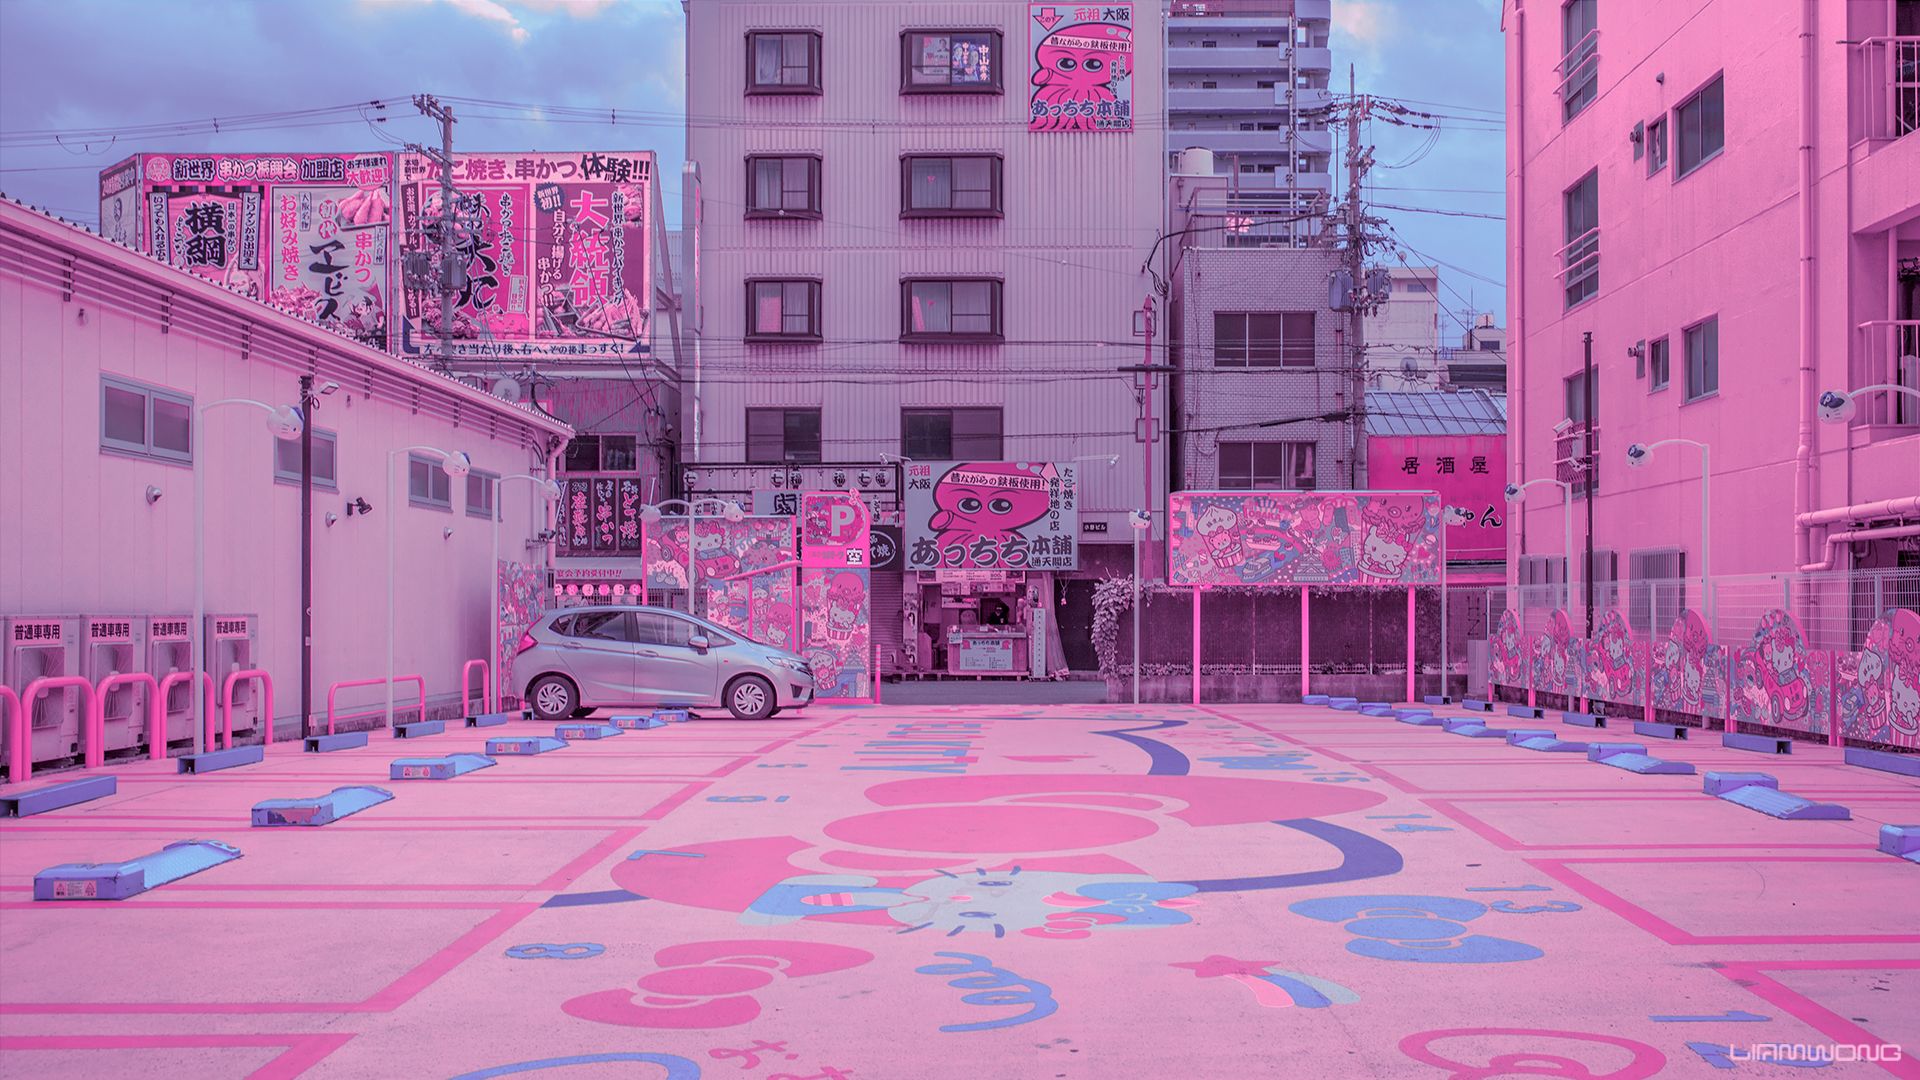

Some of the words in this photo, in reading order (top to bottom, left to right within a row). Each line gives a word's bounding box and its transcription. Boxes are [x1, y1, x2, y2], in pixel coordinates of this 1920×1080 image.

[1074, 8, 1100, 21] 元祖
[1103, 8, 1129, 21] 大阪
[1031, 99, 1131, 118] あっちち本舗
[173, 158, 215, 182] 新世界
[301, 158, 345, 181] 加盟店
[347, 157, 387, 170] お子様連れ
[346, 167, 390, 187] 大歓迎!
[184, 201, 228, 269] 横綱
[226, 202, 237, 254] 日本一の串かつ
[280, 195, 301, 281] お好み焼き
[551, 209, 566, 280] 自分で揚げる
[569, 189, 610, 308] 大統領
[355, 231, 373, 283] 串かつ
[309, 240, 350, 321] エビス
[908, 465, 931, 476] 元祖
[1402, 456, 1489, 474] 居酒屋
[908, 479, 931, 490] 大阪
[950, 469, 1046, 491] 昔ながらの鉄板使用!
[1063, 467, 1075, 511] たこ焼き
[1049, 477, 1060, 531] 発祥地の店
[831, 504, 856, 537] P
[910, 535, 1074, 567] あっちち本舗
[14, 624, 61, 640] 普通車専用
[91, 622, 130, 638] 普通車専用
[152, 621, 187, 636] 普通車専用
[216, 620, 247, 634] 普通車専用
[504, 943, 607, 959] 8
